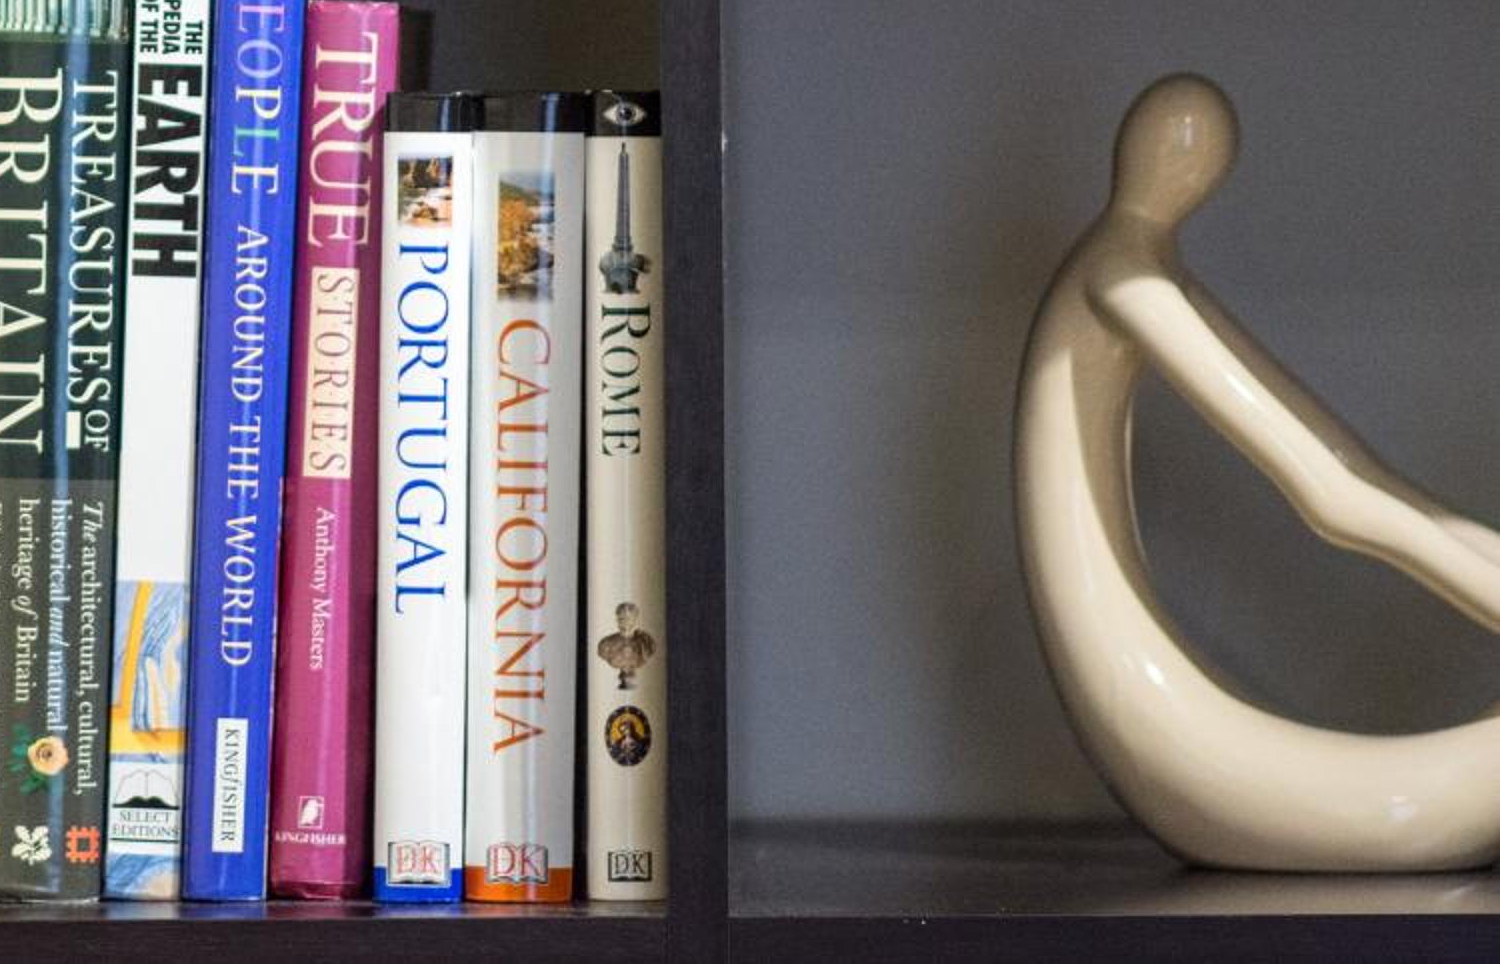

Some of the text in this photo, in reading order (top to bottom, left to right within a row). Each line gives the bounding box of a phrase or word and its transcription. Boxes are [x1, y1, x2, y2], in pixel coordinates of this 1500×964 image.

[140, 24, 159, 54] THE
[184, 20, 203, 56] THE
[132, 63, 203, 278] EARTH
[307, 31, 379, 247] TRUE
[66, 69, 119, 452] TREASURES OF
[230, 225, 270, 404] AROUND
[309, 273, 356, 472] STORIES
[395, 244, 449, 614] PORTUGAL
[601, 304, 651, 456] ROME
[226, 415, 262, 500] THE
[493, 319, 551, 756] CALIFORNIA
[11, 498, 41, 702] heritage of Britain
[46, 499, 73, 731] historical and natural
[73, 502, 104, 796] The architectural, cultural,
[221, 515, 257, 667] WORLD
[309, 507, 338, 671] Anthony Masters
[112, 824, 180, 837] EDITIONS
[118, 811, 172, 824] SELECT
[395, 843, 442, 876] DK
[491, 843, 545, 876] DK
[613, 852, 646, 876] DK
